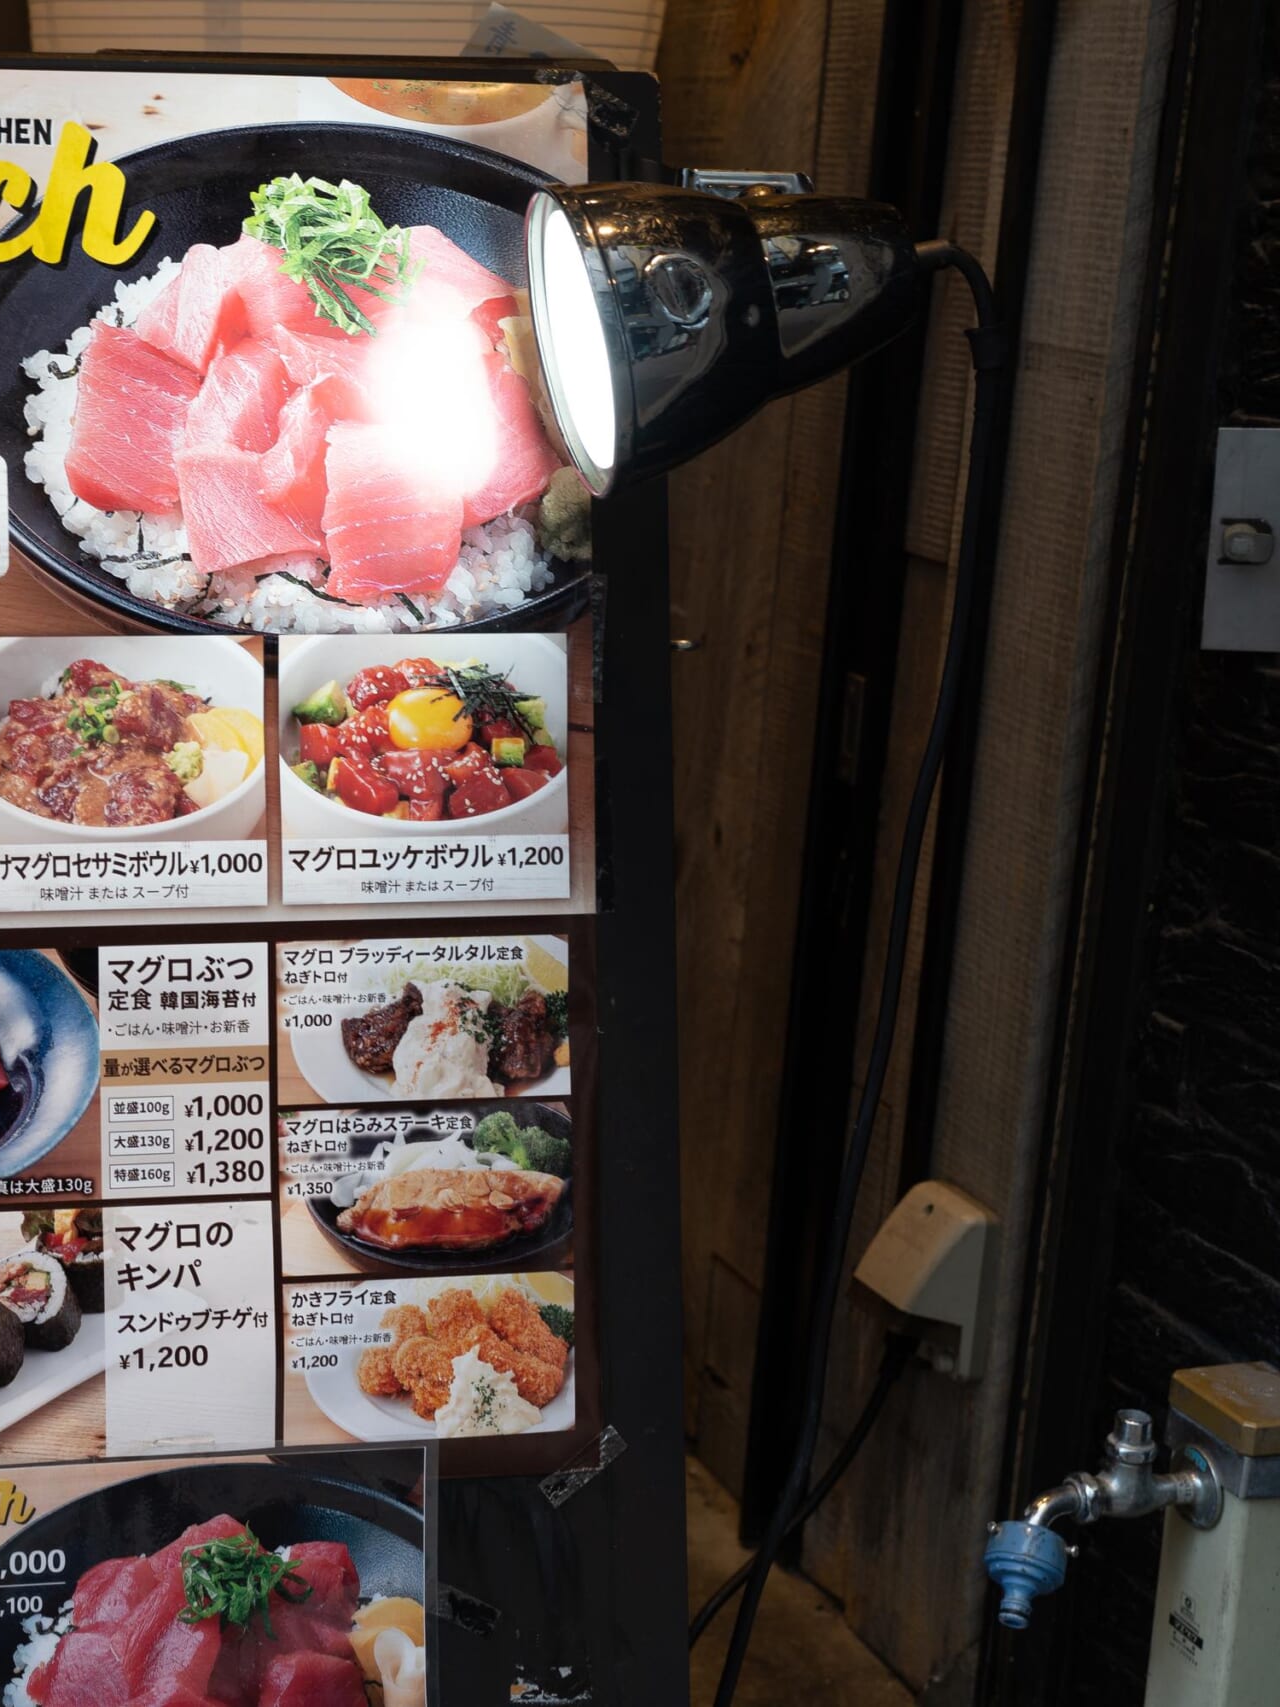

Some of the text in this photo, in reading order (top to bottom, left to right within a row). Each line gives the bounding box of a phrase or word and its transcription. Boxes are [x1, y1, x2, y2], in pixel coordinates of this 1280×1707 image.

[190, 853, 262, 878] ¥1,000
[289, 843, 563, 873] マグロユッケボウル ¥1,200
[40, 884, 189, 901] 味噌汁 または スープ付
[361, 878, 494, 894] 味噌汁 または スープ付
[284, 948, 333, 966] マグロ
[107, 955, 254, 985] マグロぶつ
[284, 970, 348, 985] ねぎトロ付
[108, 989, 257, 1011] 定食 韓国海苔付
[284, 1014, 333, 1029] ¥1,000
[103, 1055, 265, 1078] 量が選べるマグロぶつ
[113, 1094, 264, 1121] 並盛100g ¥1,000
[286, 1114, 473, 1136] マグロはらみステーキ定食
[114, 1128, 264, 1155] 大盛130g ¥1,200
[287, 1140, 348, 1154] ねぎトロ付
[114, 1160, 264, 1187] 特盛160g ¥1,380
[287, 1181, 333, 1197] ¥1,350
[114, 1221, 234, 1252] マグロの
[117, 1259, 202, 1292] キンパ
[291, 1289, 396, 1309] かきフライ定食
[118, 1307, 268, 1335] スンドゥブチゲ付
[292, 1312, 354, 1327] ねぎトロ付
[119, 1344, 208, 1371] ¥1,200
[292, 1354, 338, 1370] ¥1,200
